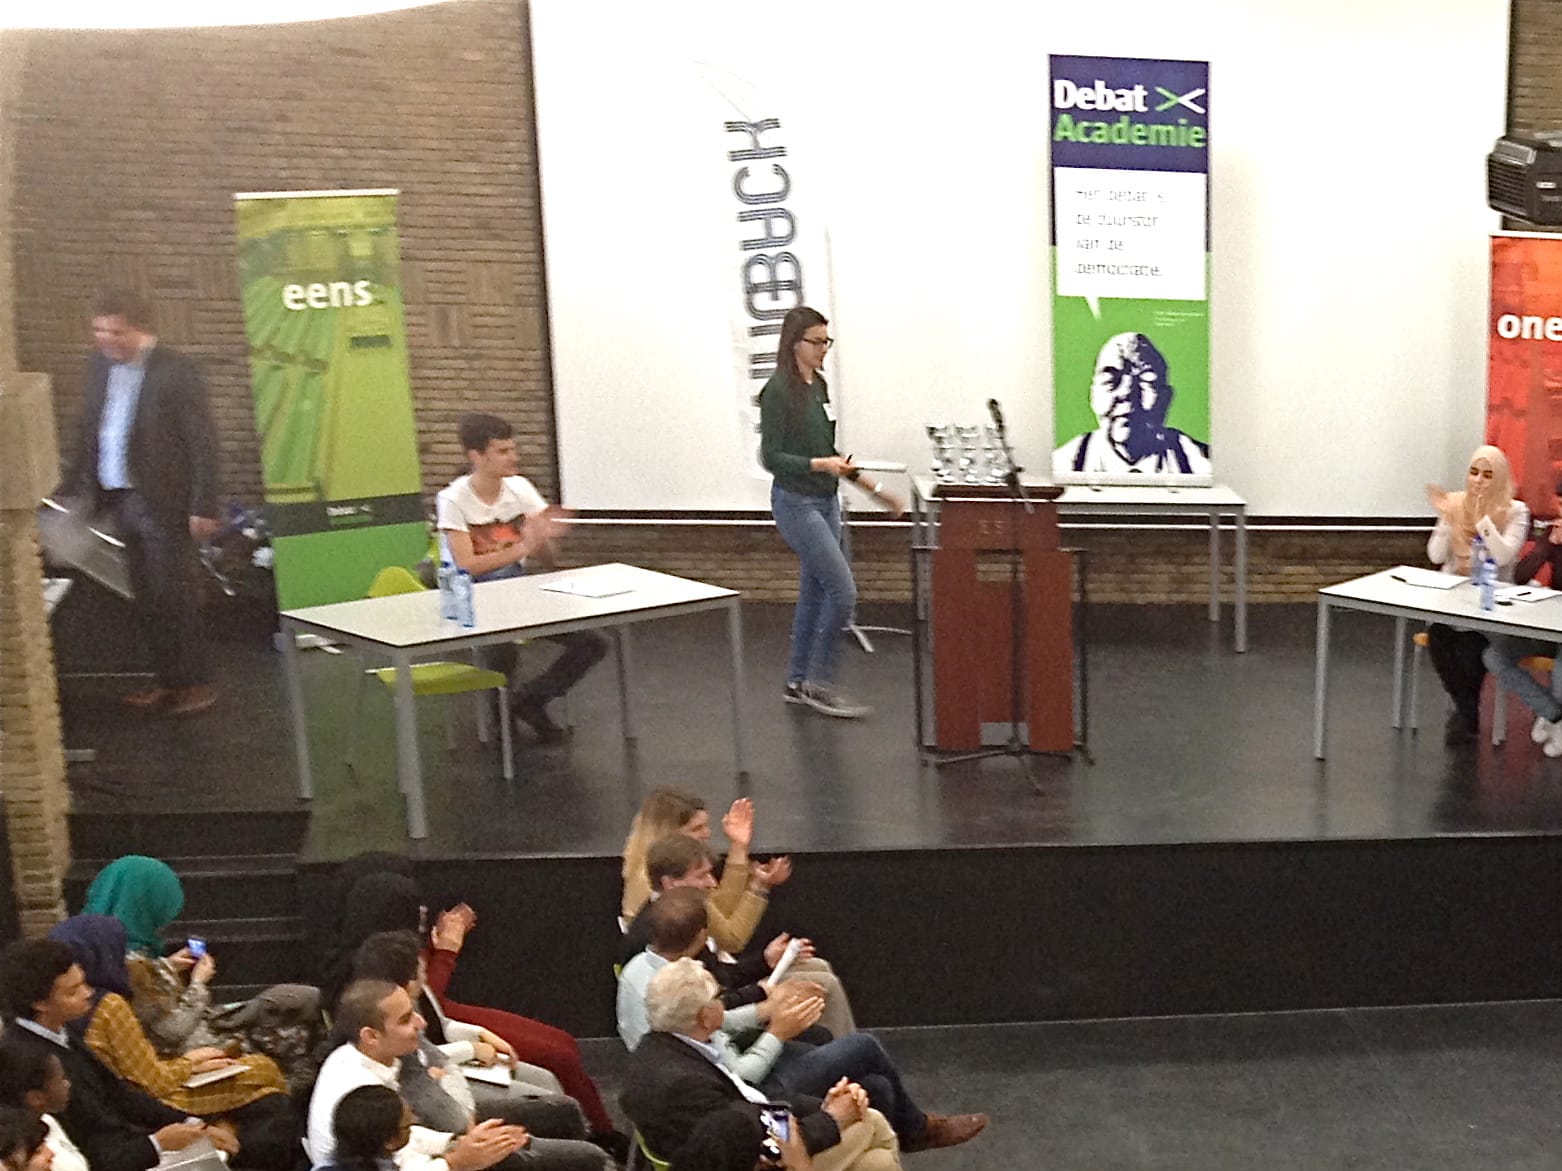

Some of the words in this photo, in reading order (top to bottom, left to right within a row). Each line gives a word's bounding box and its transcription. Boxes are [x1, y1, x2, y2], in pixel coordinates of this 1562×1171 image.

[1053, 79, 1148, 112] Debat
[1053, 113, 1206, 148] Academie
[282, 280, 373, 311] eens
